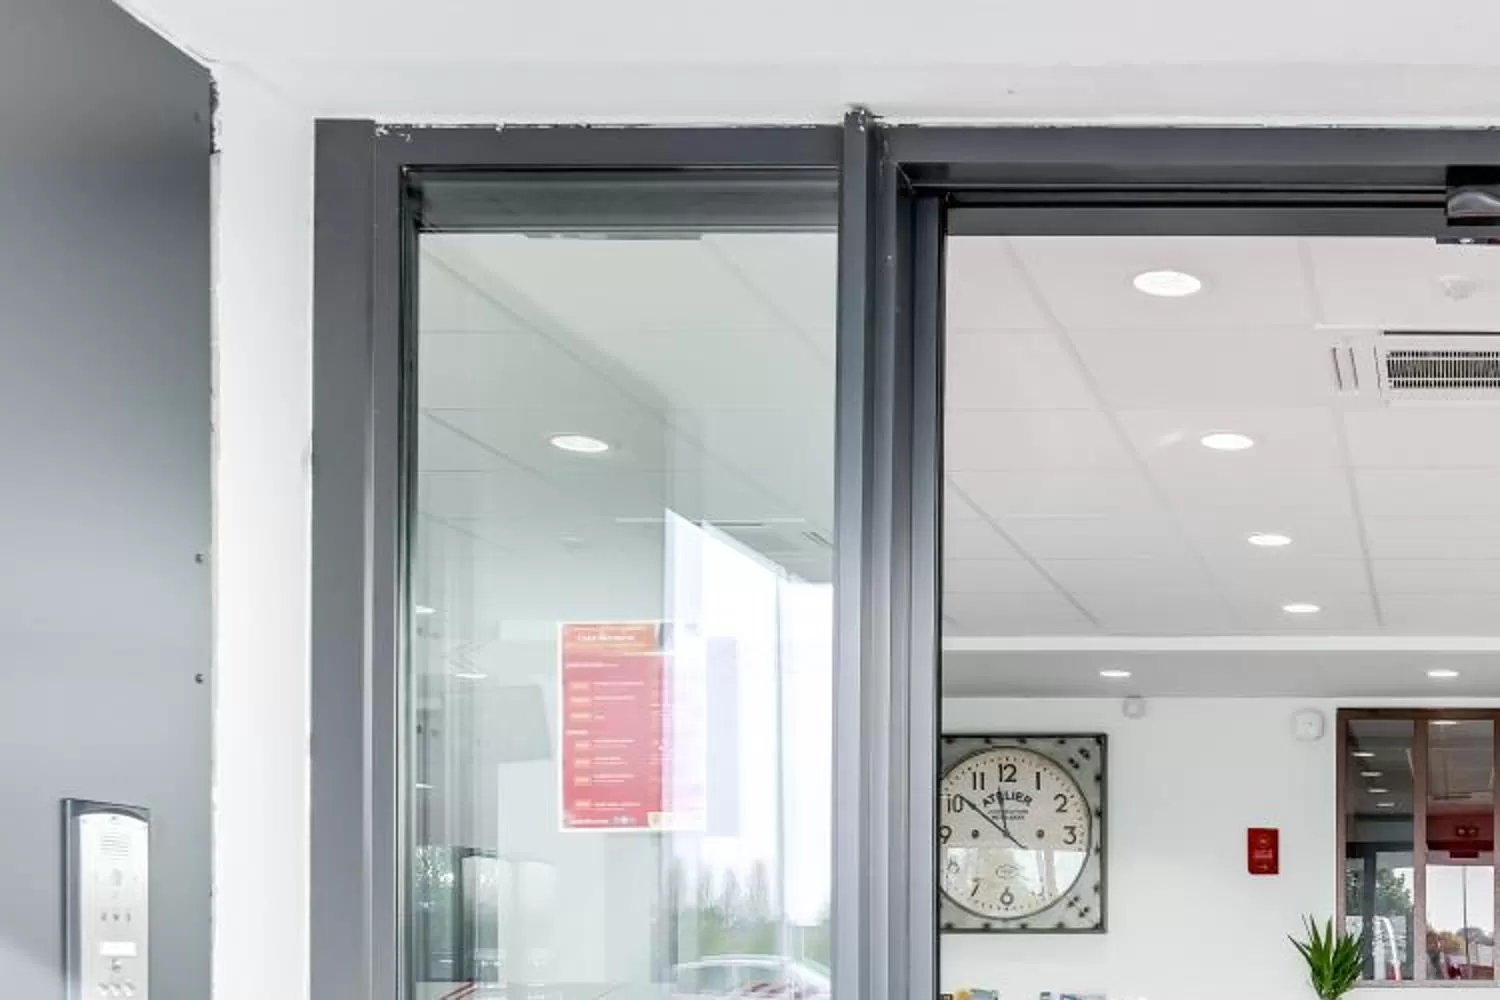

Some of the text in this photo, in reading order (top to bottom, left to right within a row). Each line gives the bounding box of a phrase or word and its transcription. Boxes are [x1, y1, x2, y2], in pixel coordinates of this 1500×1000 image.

[972, 771, 985, 790] 11
[998, 763, 1017, 783] 12
[1035, 771, 1041, 790] 1
[947, 794, 963, 813] 10
[1053, 793, 1068, 813] 2
[940, 825, 952, 844] 9
[1063, 825, 1077, 844] 3
[971, 877, 984, 896] 7
[1000, 886, 1014, 905] 6
